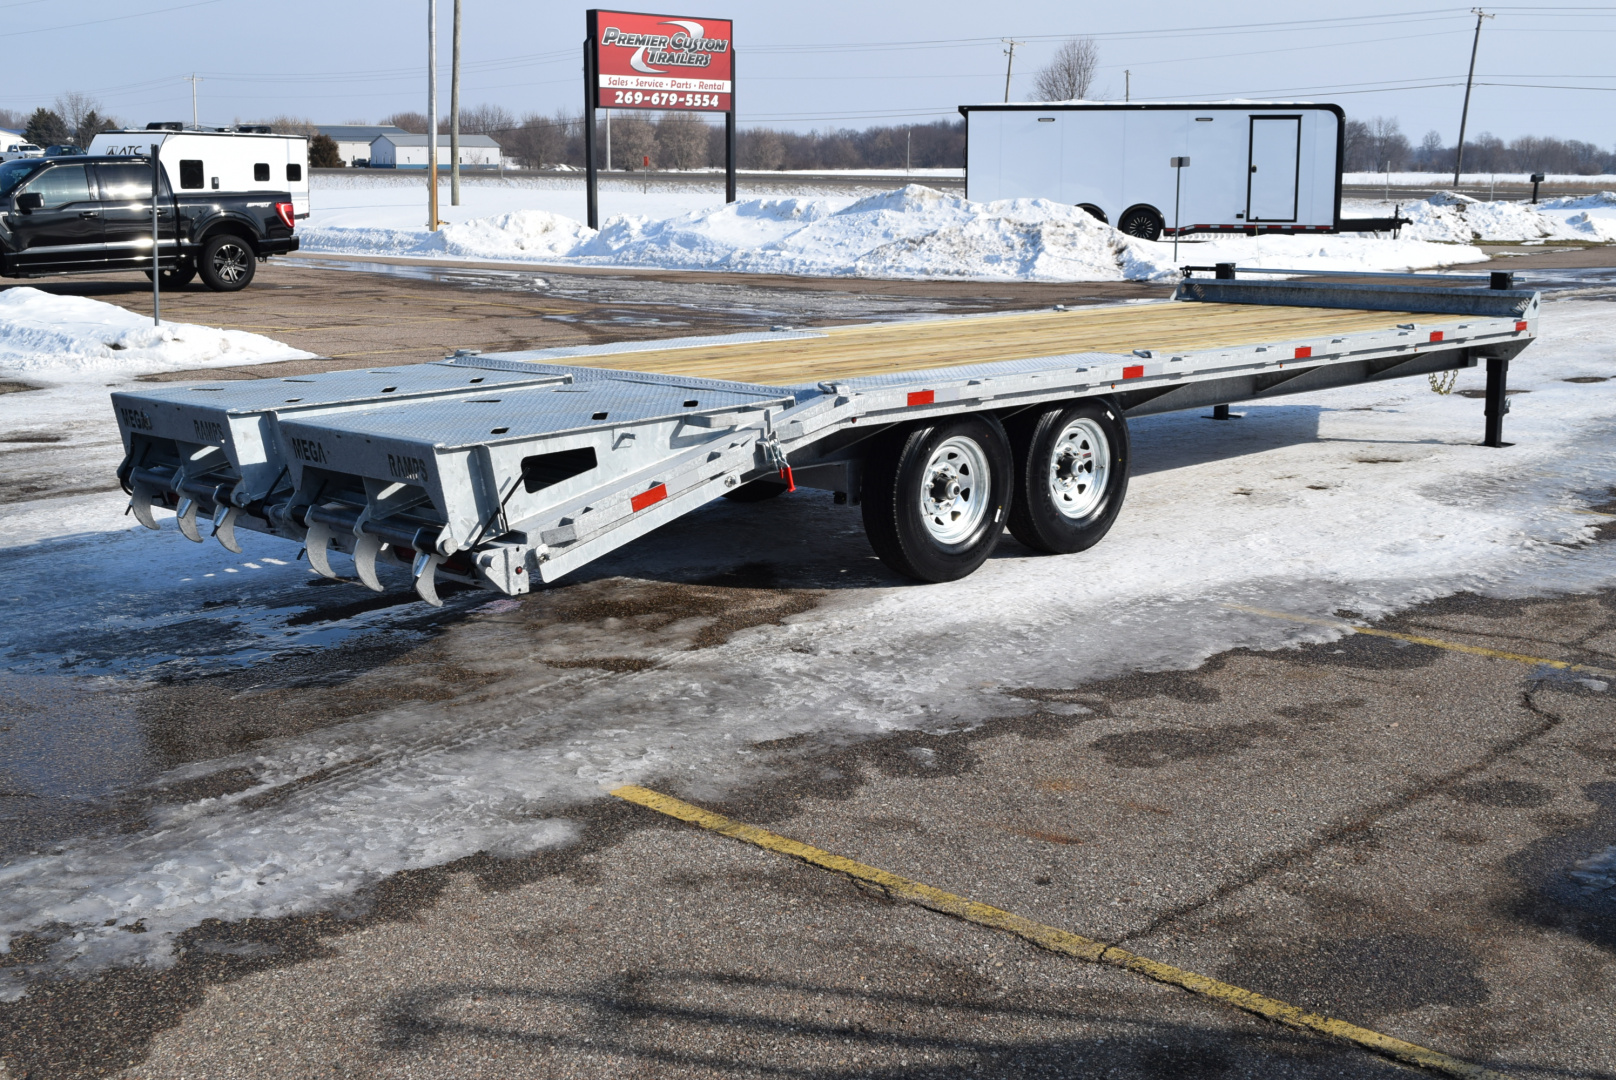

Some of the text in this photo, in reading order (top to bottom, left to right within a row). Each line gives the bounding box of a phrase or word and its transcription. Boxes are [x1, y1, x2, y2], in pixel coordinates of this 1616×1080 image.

[602, 27, 728, 52] PREMIER CUSTOM
[647, 47, 711, 67] TRAILERS
[608, 77, 724, 91] Sales Service Parts Rental
[615, 91, 719, 107] 269-679-5554
[119, 145, 142, 155] ATC
[120, 407, 225, 442] MEGA RAMPS
[291, 437, 428, 482] MEGA RAMPS
